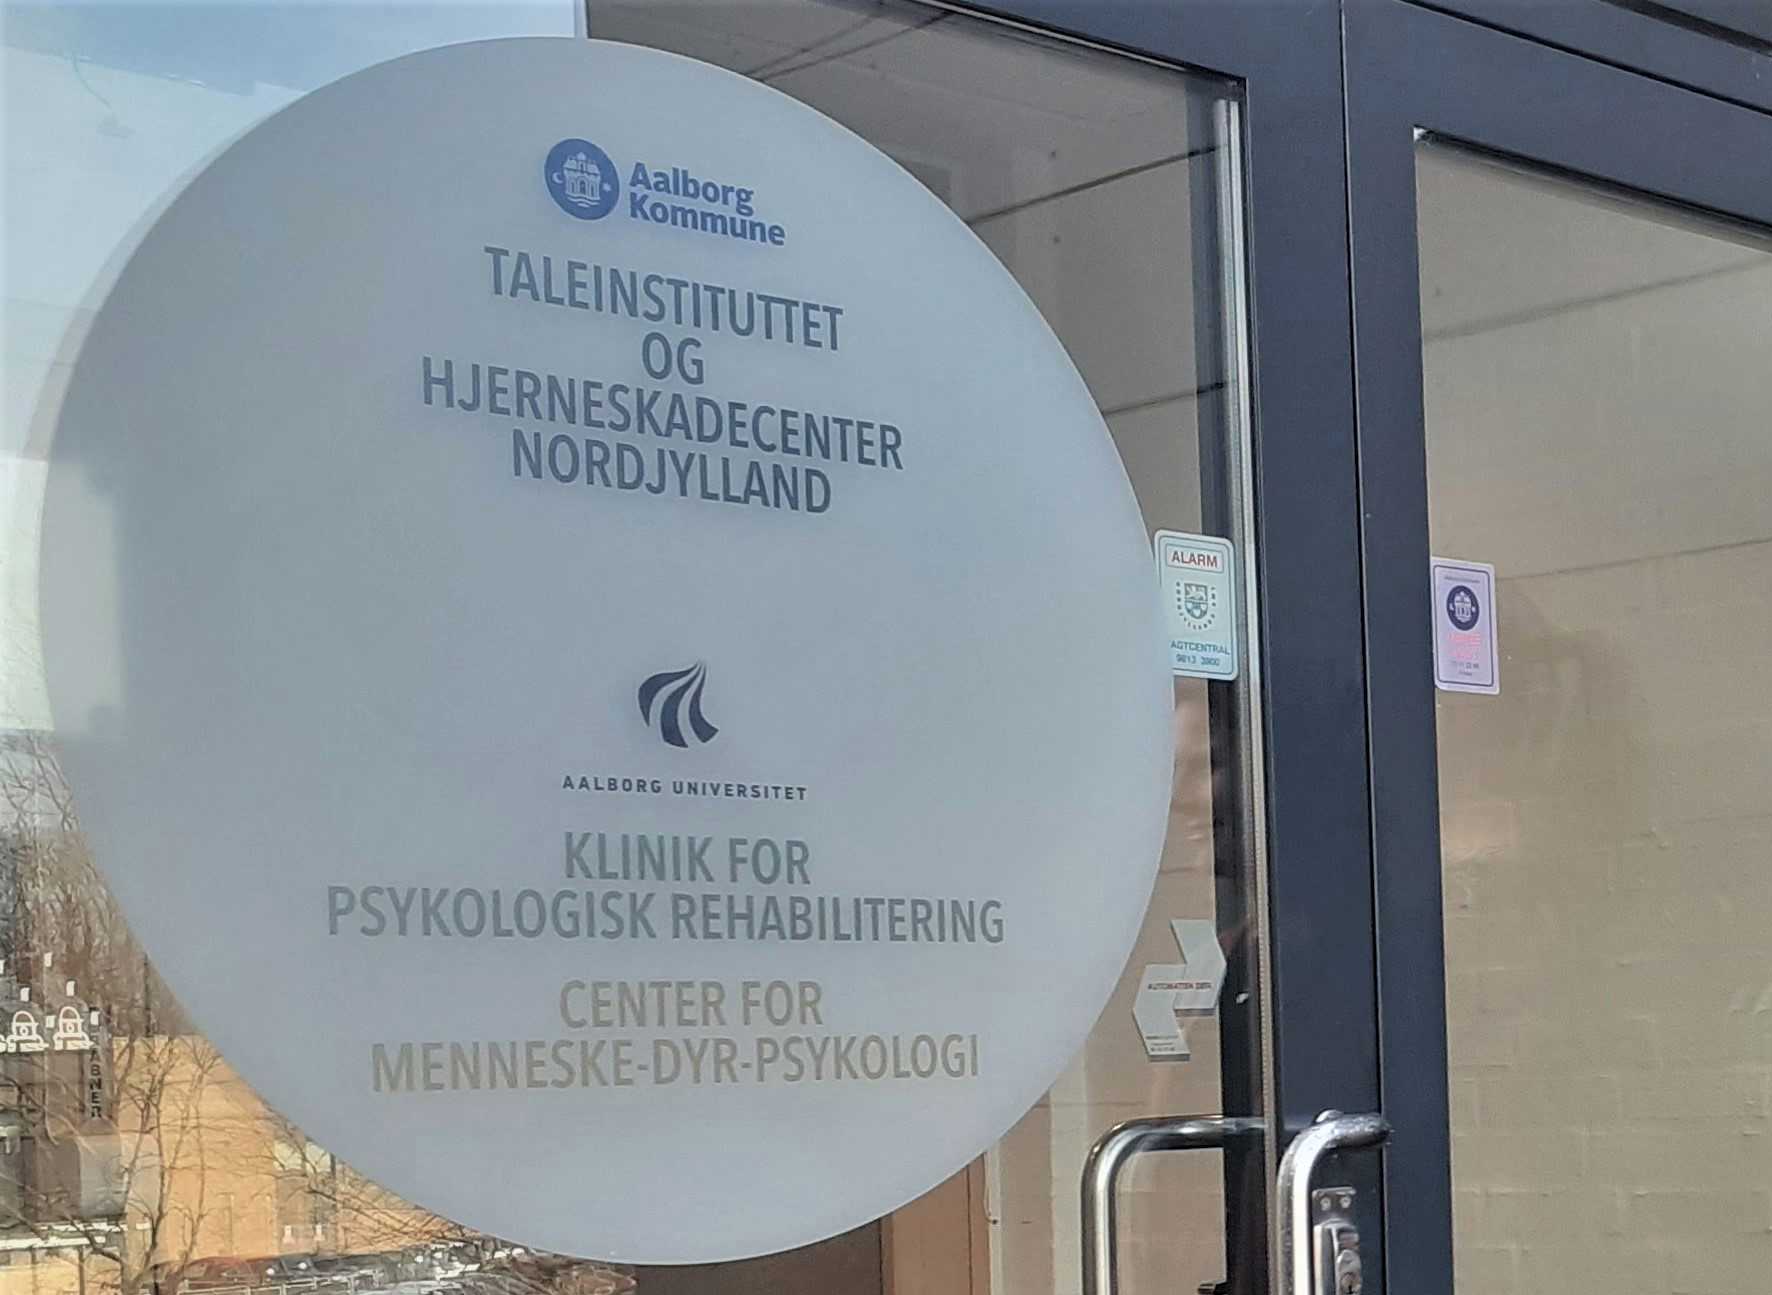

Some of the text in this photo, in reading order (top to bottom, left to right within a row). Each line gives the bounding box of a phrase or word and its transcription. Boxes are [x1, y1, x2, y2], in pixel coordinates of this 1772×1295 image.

[628, 161, 756, 218] Aalborg
[628, 191, 786, 247] Kommune
[484, 245, 844, 352] TALEINSTITUTTET
[641, 331, 706, 386] OG
[422, 355, 904, 471] HJERNESKADECENTER
[512, 428, 832, 515] NORDJYLLAND
[1171, 550, 1218, 568] ALARM
[562, 774, 808, 801] AALBORG UNIVERSITET
[564, 831, 813, 886] KLINIK FOR
[327, 885, 1005, 944] PSYKOLOGISK REHABILITERING
[559, 979, 824, 1029] CENTER FOR
[371, 1033, 979, 1093] MENNESKE-DYR-PSYKOLOGI
